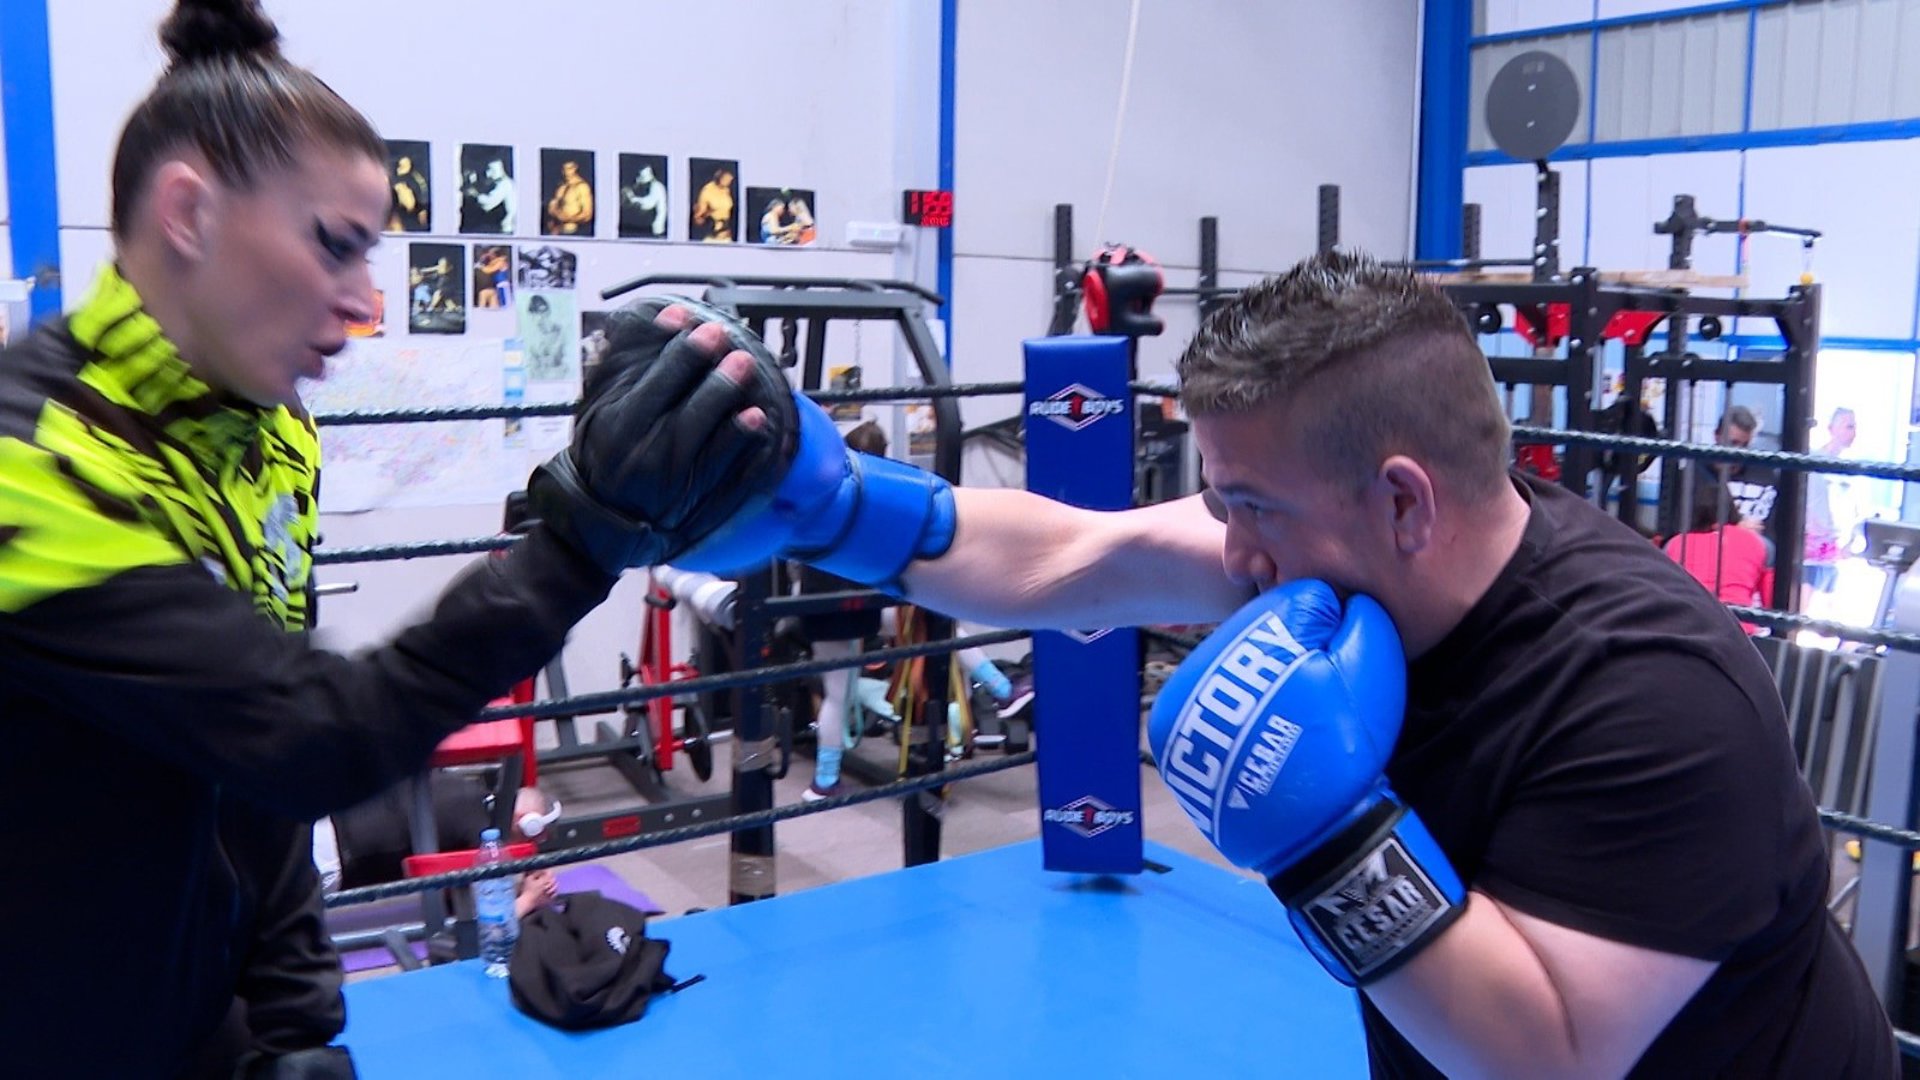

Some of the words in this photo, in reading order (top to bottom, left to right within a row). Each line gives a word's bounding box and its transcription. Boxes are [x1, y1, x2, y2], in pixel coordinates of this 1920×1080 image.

[1029, 401, 1072, 416] RUDE
[1081, 399, 1125, 416] BOYS
[1043, 809, 1084, 823] RUDE
[1092, 811, 1134, 825] BOYS
[1335, 880, 1427, 948] CESAR
